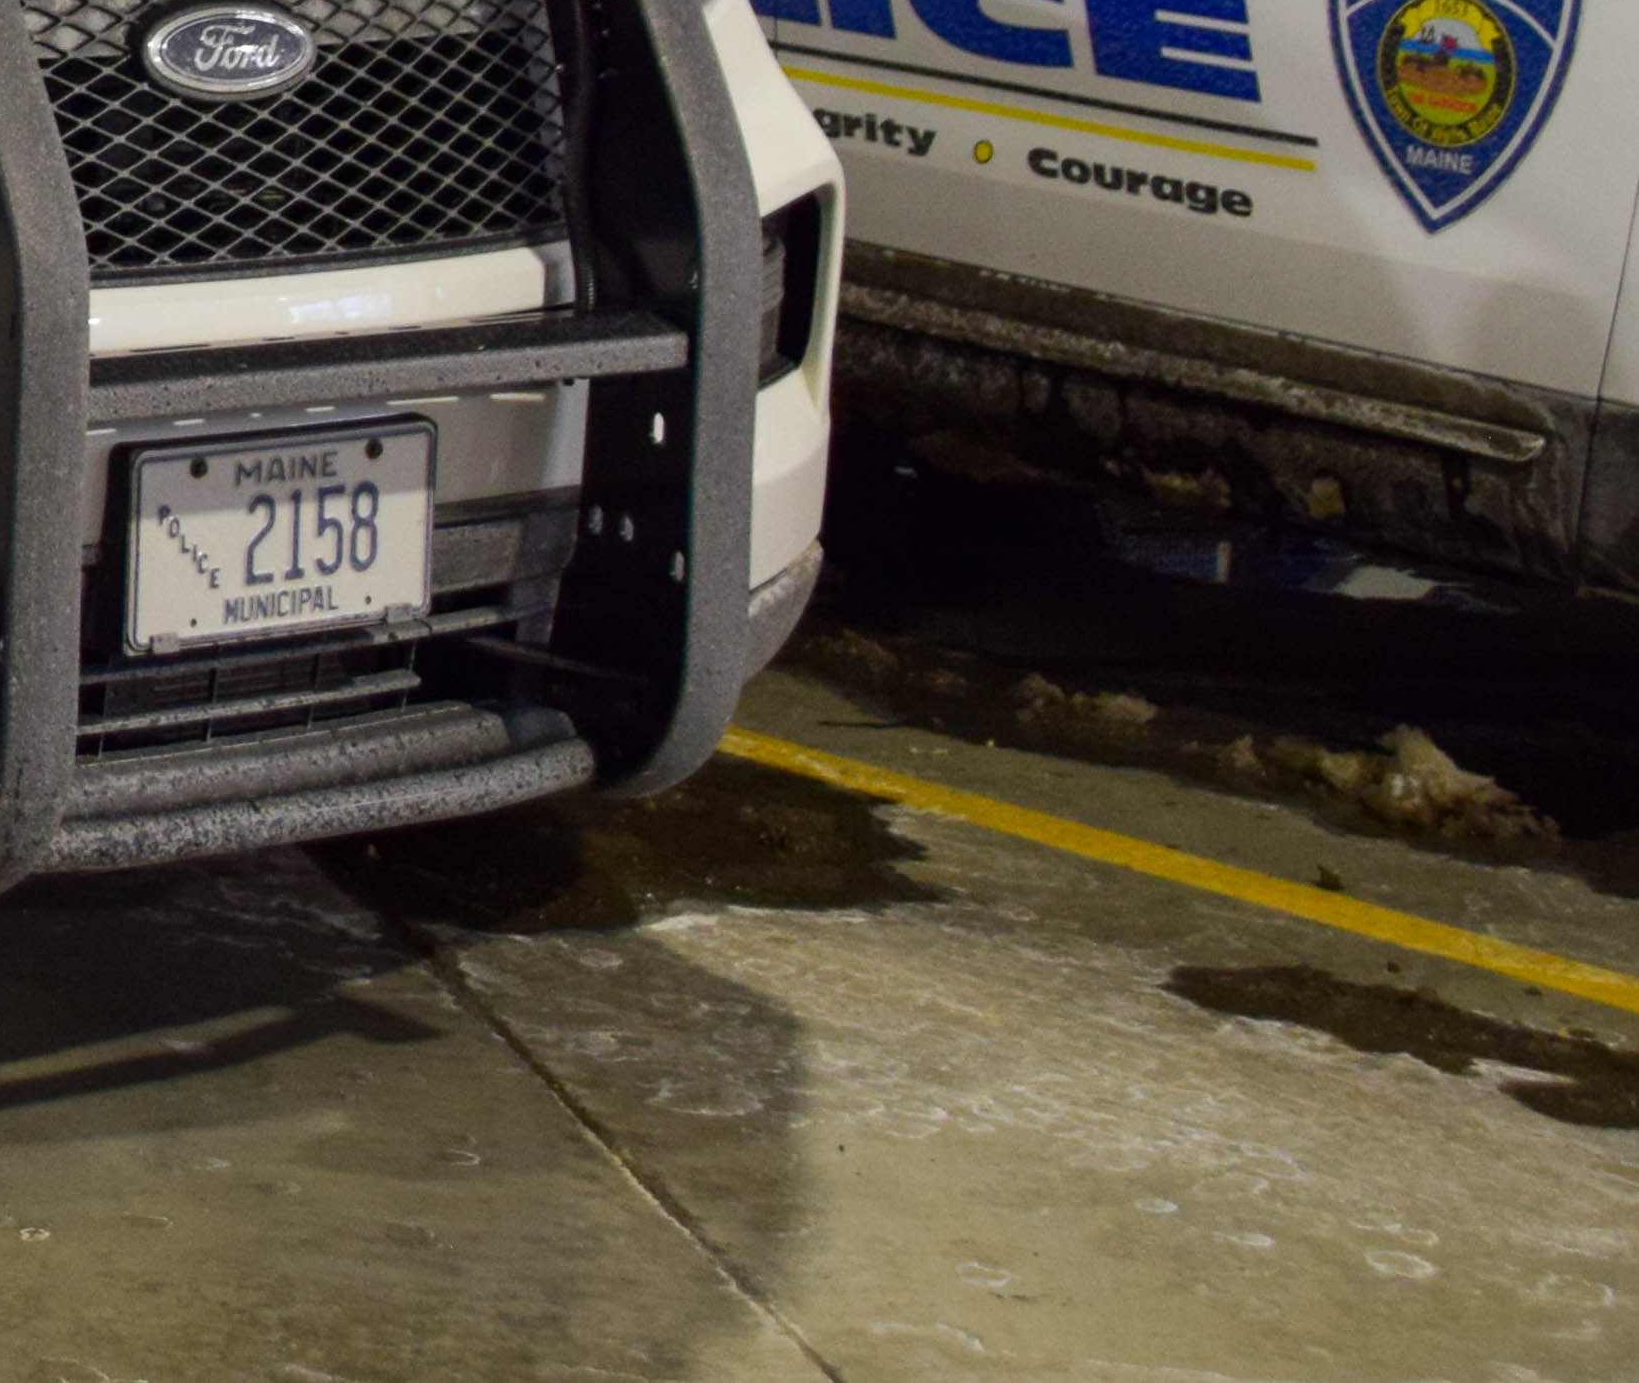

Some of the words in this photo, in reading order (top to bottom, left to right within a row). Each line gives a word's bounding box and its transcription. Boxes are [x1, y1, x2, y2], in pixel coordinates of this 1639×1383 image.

[194, 23, 280, 71] Ford
[813, 108, 937, 157] grity
[1027, 146, 1254, 218] Courage
[1405, 144, 1474, 174] MAINE
[234, 450, 339, 488] MAINE
[157, 504, 220, 589] POLICE
[244, 480, 379, 587] 2158
[223, 585, 339, 625] MUNICIPAL
